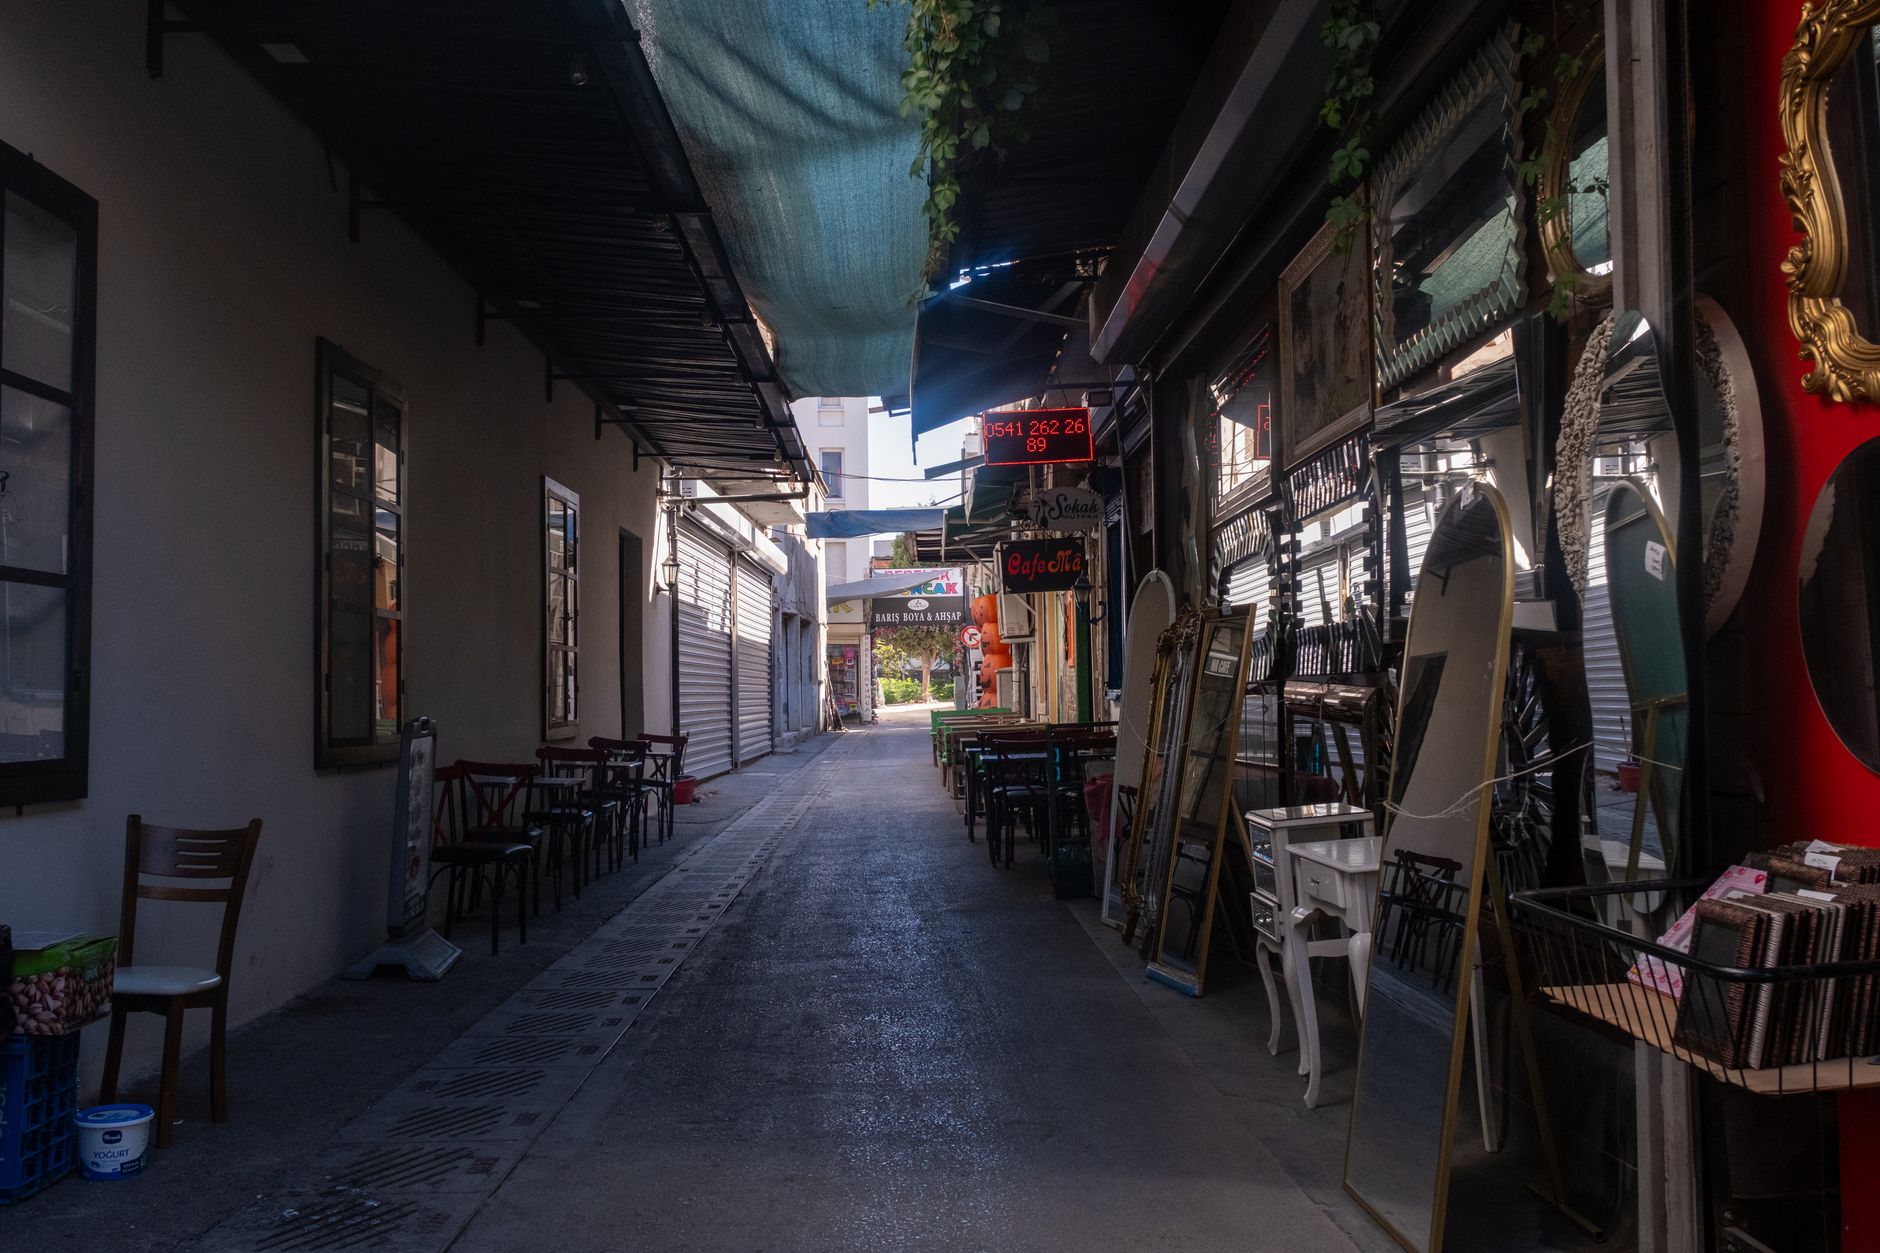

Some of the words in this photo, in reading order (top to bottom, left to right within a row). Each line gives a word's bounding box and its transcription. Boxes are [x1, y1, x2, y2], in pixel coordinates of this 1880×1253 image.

[986, 421, 1023, 438] 0541
[1029, 420, 1060, 435] 262
[1065, 419, 1084, 434] 26
[1026, 437, 1047, 452] 89
[1048, 494, 1099, 520] Sokak
[1007, 551, 1046, 582] Cafe
[875, 613, 900, 624] BARIŞ
[903, 612, 925, 622] BOYA
[926, 612, 933, 621] &
[934, 611, 962, 623] AHŞAP
[93, 1149, 129, 1159] YOĞURT
